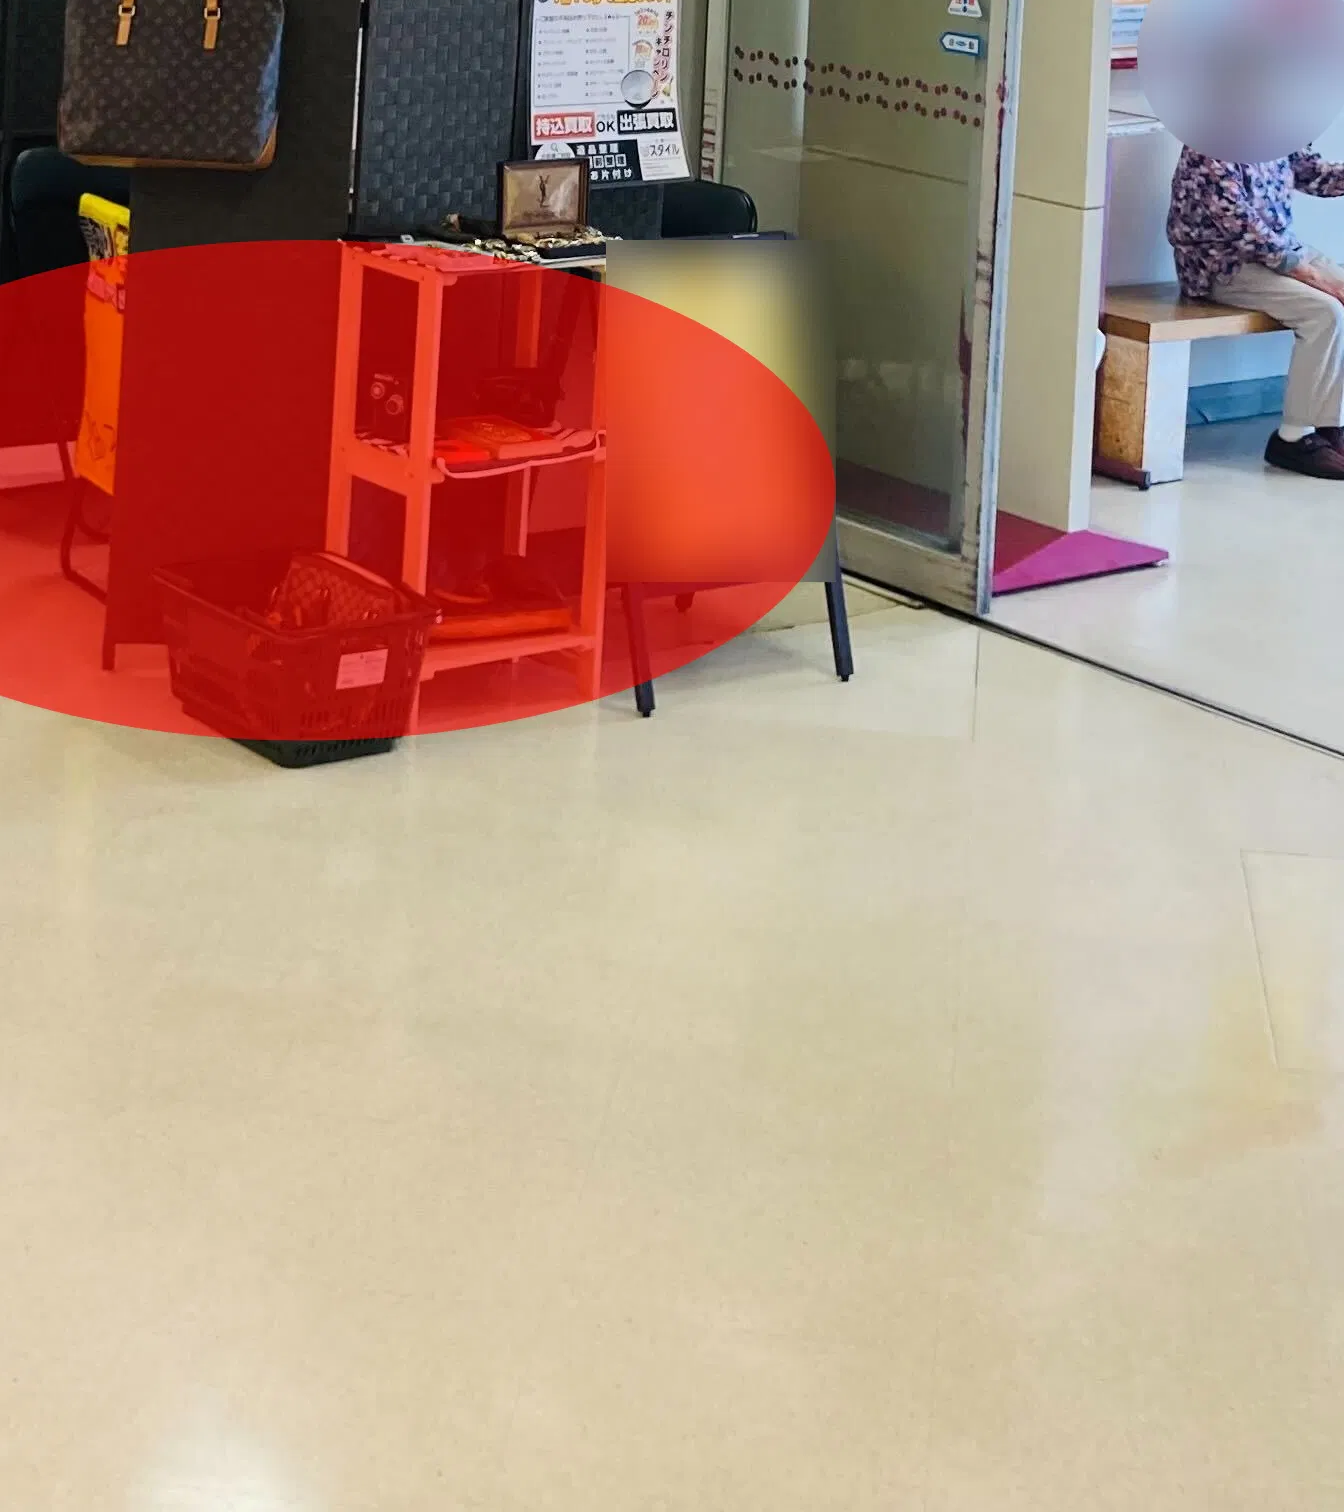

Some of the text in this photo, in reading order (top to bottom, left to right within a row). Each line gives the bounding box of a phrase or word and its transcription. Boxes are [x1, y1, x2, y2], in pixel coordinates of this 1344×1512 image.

[536, 112, 675, 136] 持込買取 OK 出張買取
